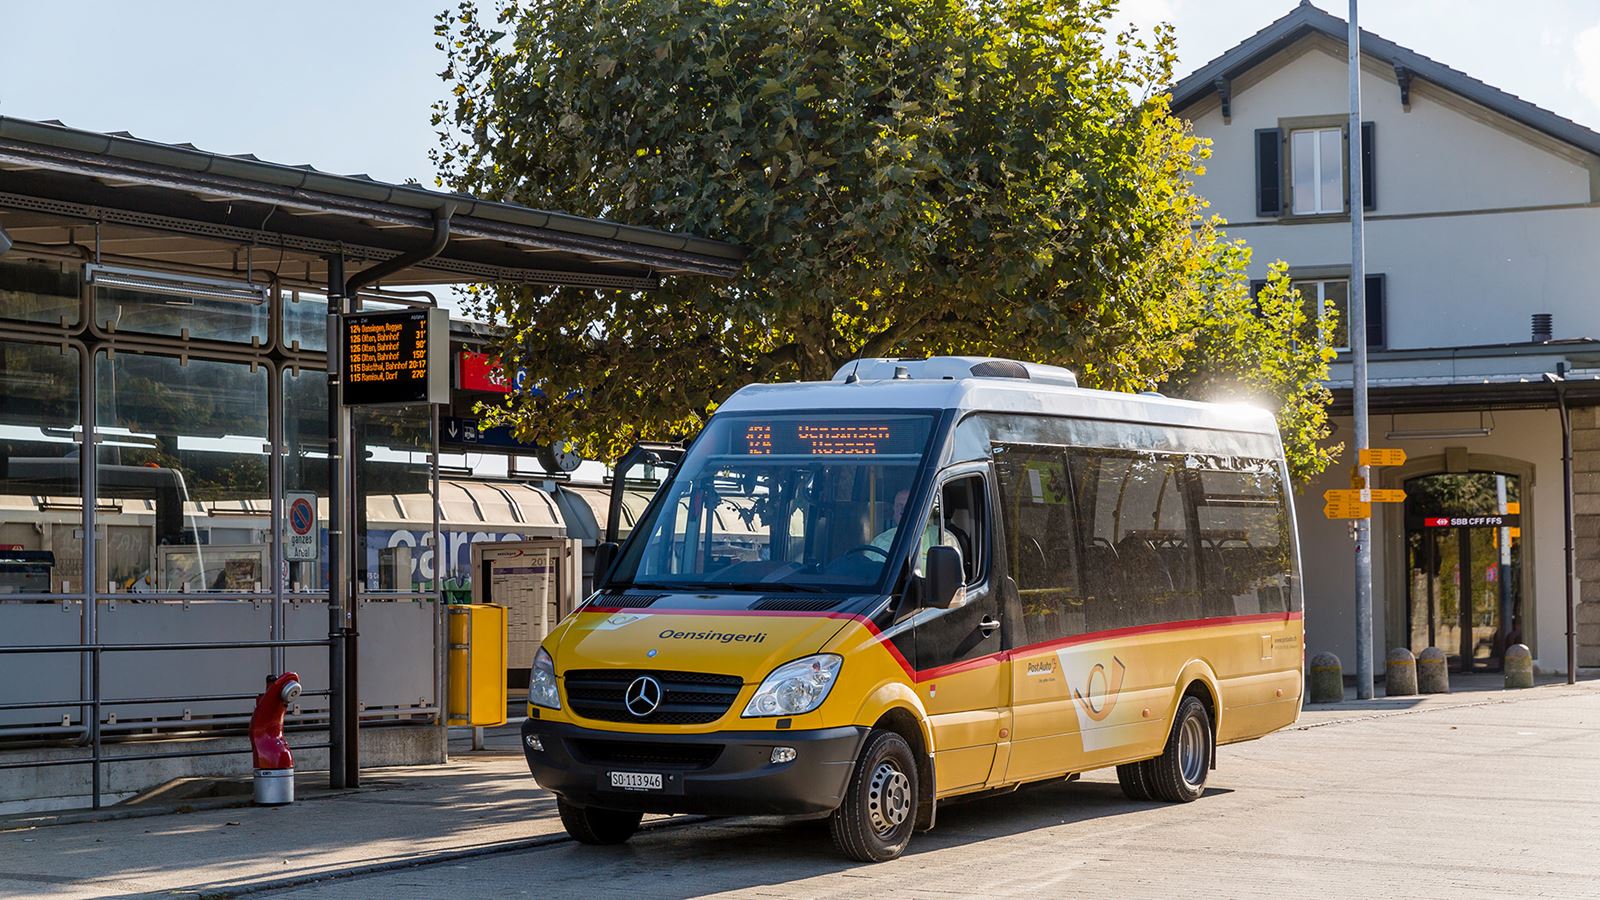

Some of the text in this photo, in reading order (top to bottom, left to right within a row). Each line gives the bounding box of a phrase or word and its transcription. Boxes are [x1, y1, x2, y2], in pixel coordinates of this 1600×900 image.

[350, 325, 361, 333] 124
[350, 334, 361, 343] 126
[376, 332, 400, 341] Bahnhof
[350, 343, 361, 352] 126
[376, 341, 400, 350] Bahnhof
[350, 353, 361, 362] 126
[376, 351, 400, 360] Bahnhof
[350, 364, 361, 372] 115
[385, 360, 408, 370] Bahnhof
[408, 360, 426, 369] 20:17
[350, 373, 361, 382] 115
[385, 371, 398, 380] Dorf
[1450, 517, 1502, 526] SBB CFF FFS
[291, 535, 313, 547] ganzes
[388, 530, 522, 579] car
[658, 629, 768, 644] Oensingerli
